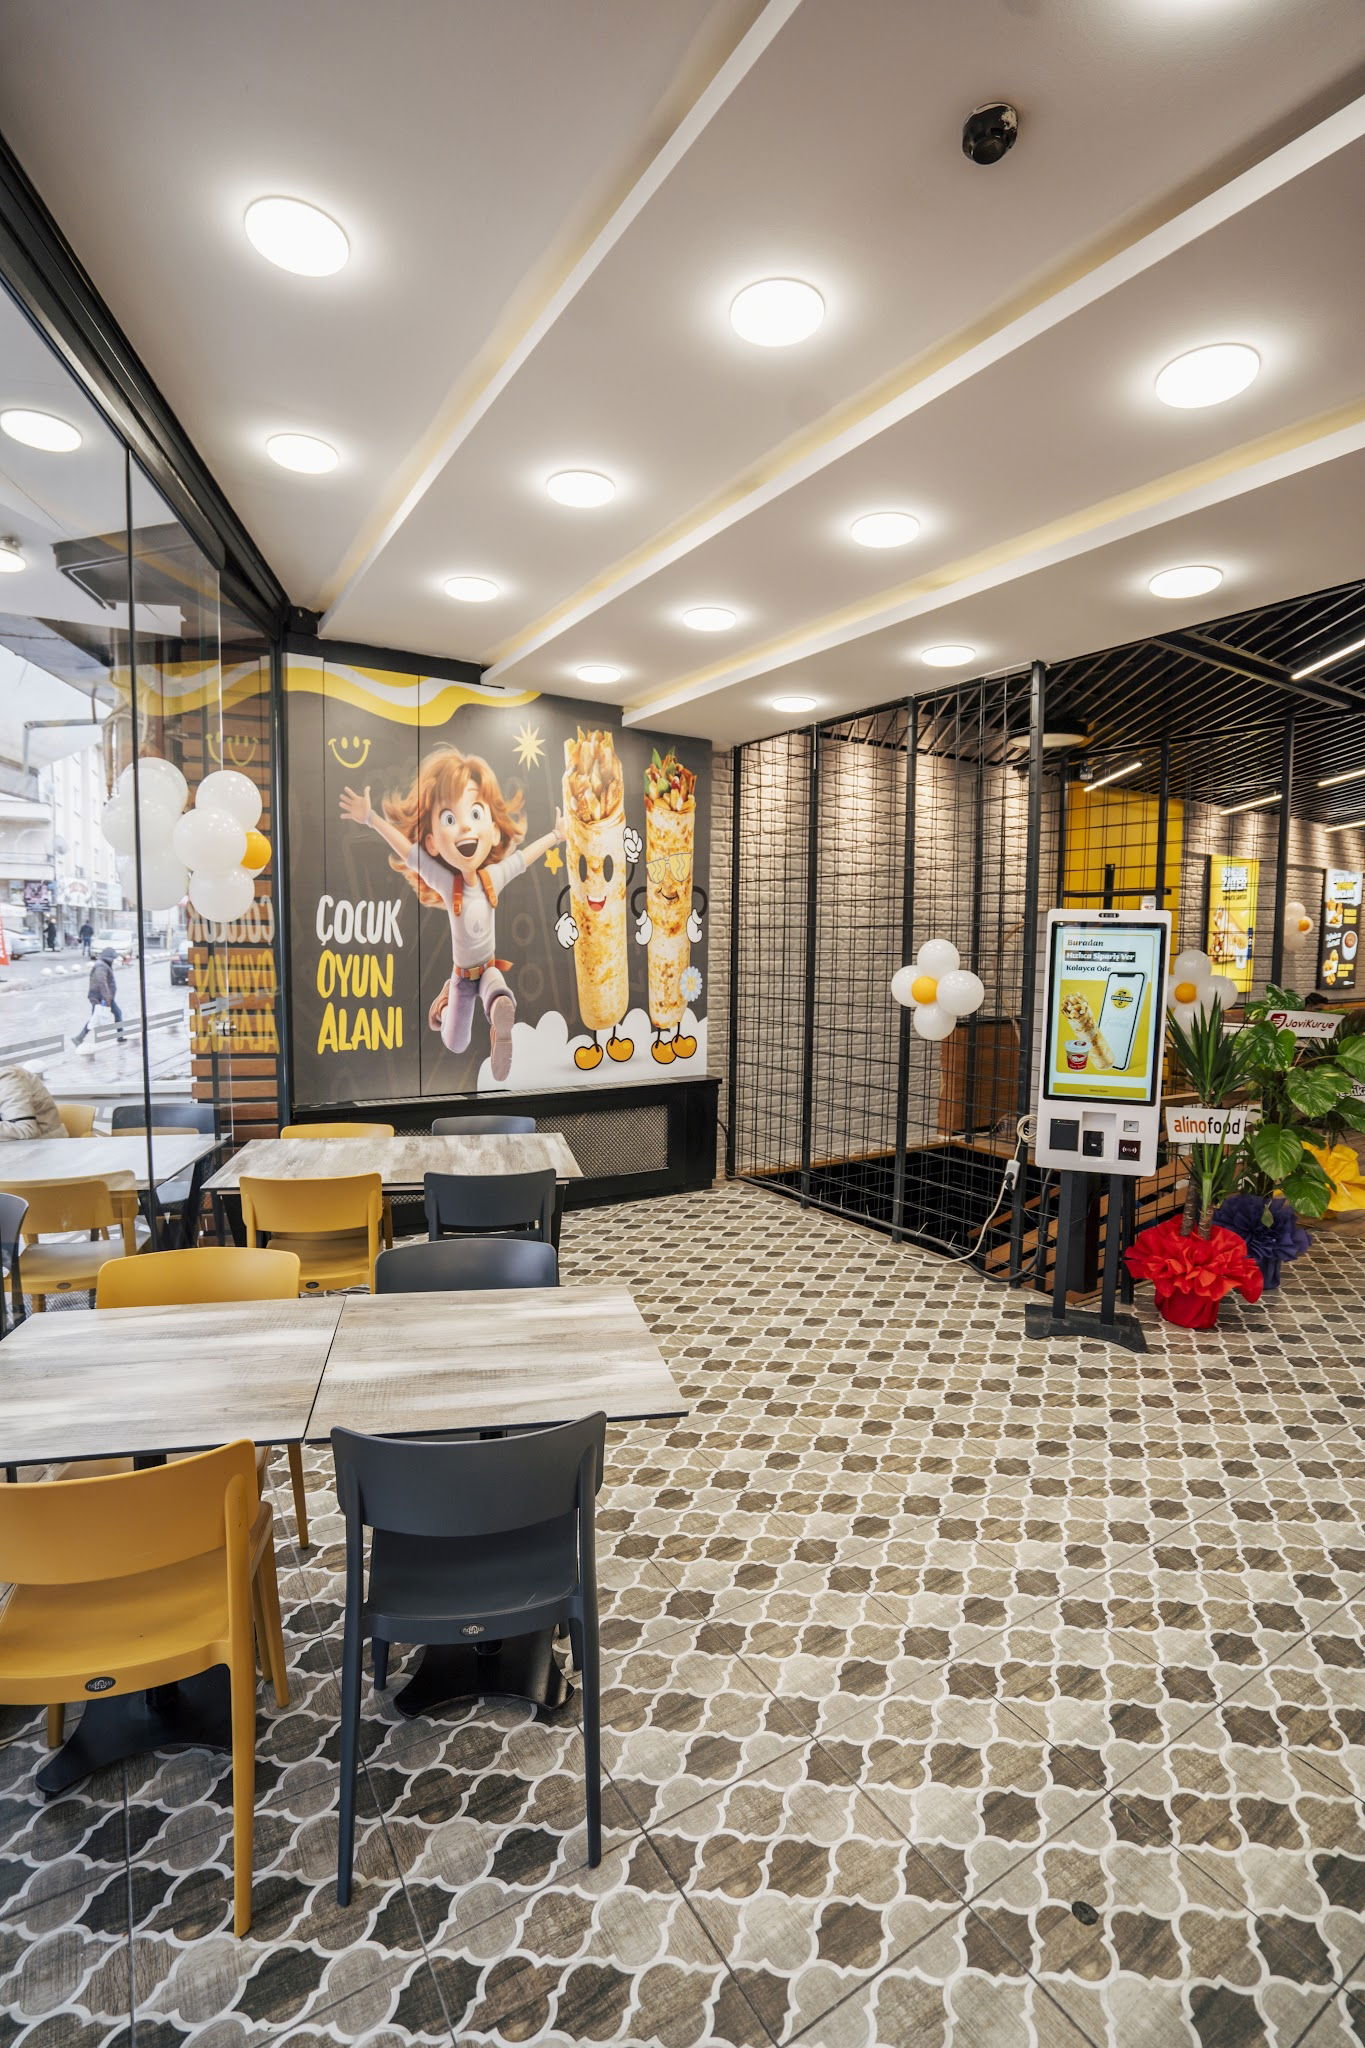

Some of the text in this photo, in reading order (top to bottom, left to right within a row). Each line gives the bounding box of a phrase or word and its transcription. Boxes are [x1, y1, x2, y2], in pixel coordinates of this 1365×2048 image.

[316, 894, 403, 947] ÇOCUK
[1067, 939, 1104, 947] Buradan
[1121, 953, 1135, 961] Ver
[316, 949, 394, 998] OYUN
[1066, 964, 1095, 973] Kolayca
[317, 1001, 403, 1055] ALANI
[1174, 1115, 1241, 1134] alinofood
